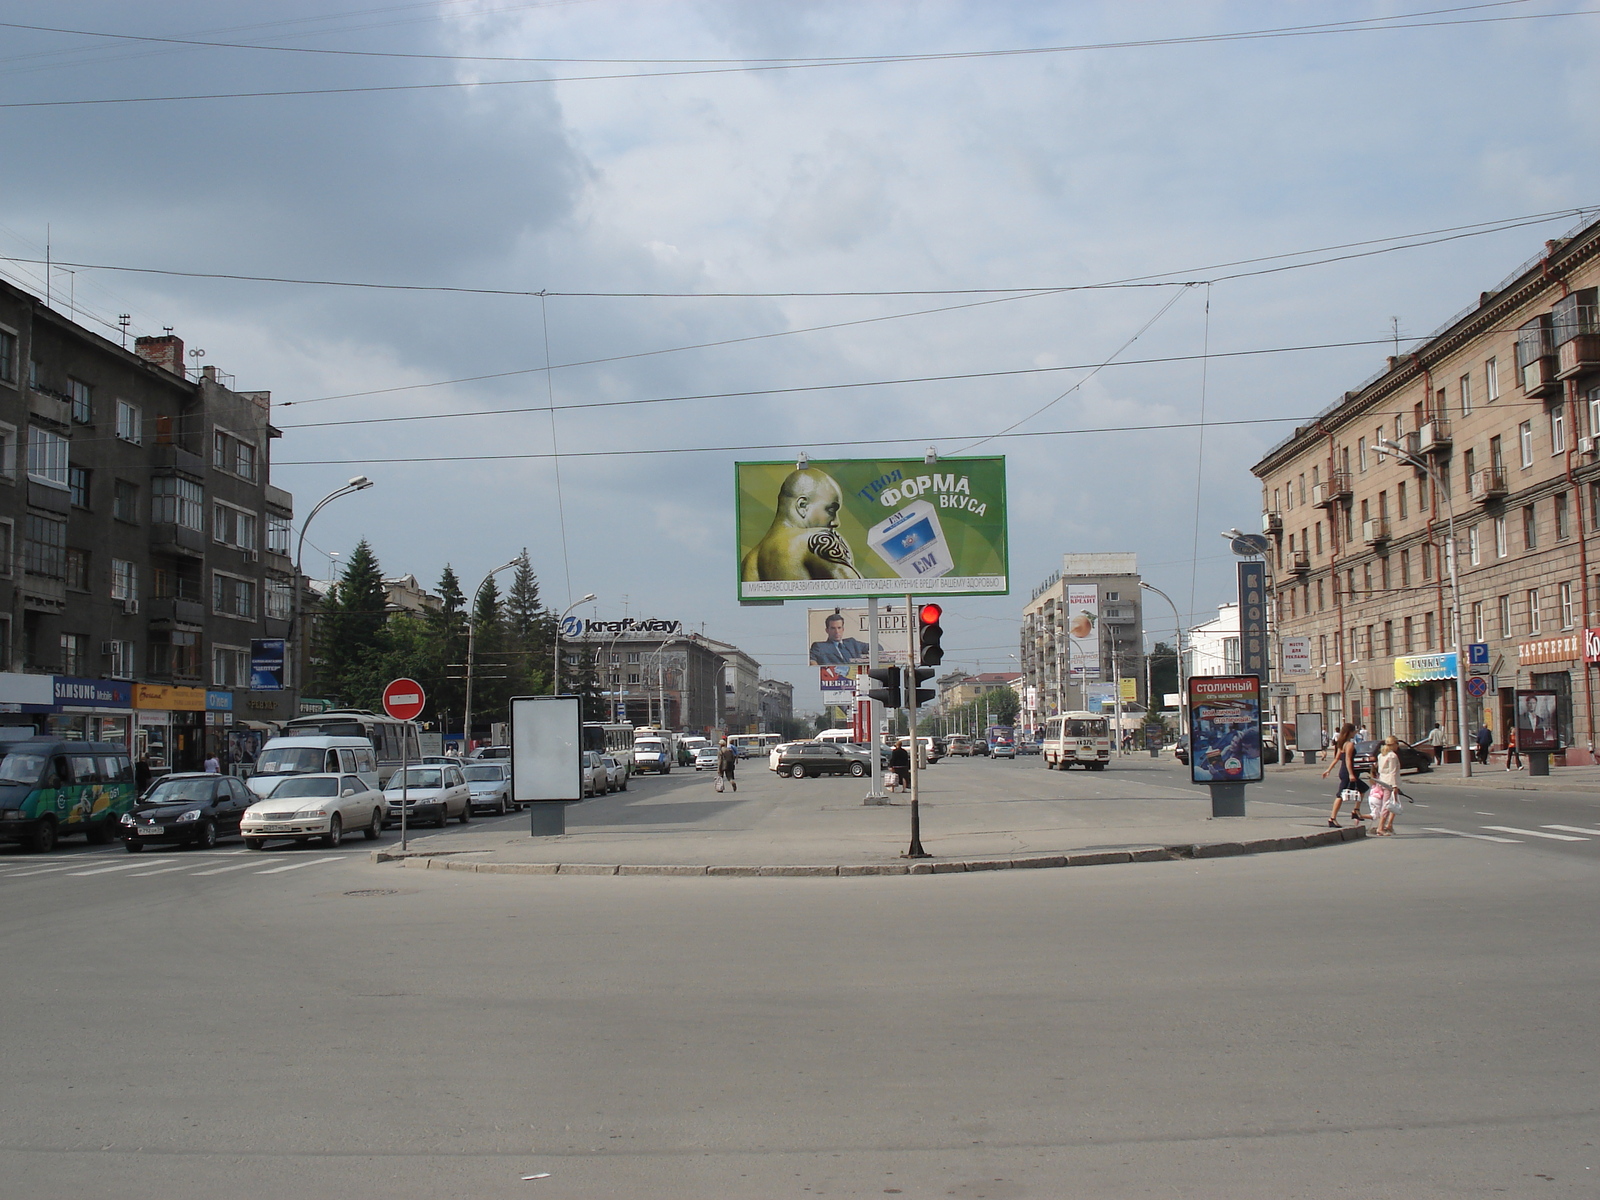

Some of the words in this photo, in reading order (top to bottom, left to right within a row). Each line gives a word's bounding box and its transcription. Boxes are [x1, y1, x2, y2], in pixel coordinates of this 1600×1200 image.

[857, 469, 903, 503] ТВОЯ
[880, 473, 970, 507] ФОРМА
[939, 494, 987, 517] ВКУСА
[748, 580, 820, 593] МИНЗДРАВСОЦРАЗВИТИЯ
[821, 580, 847, 591] РОССИИ
[895, 579, 919, 589] КУРЕНИЕ
[920, 578, 940, 589] ВРЕДИТ
[941, 578, 965, 588] ВАШЕМУ
[967, 577, 999, 588] ЗДОРОВЬЮ
[585, 618, 679, 633] kraftway
[1473, 646, 1485, 662] P
[1518, 635, 1578, 657] КАФЕТЕРИЙ
[55, 682, 95, 700] SAMSUNG
[1196, 681, 1253, 693] СТОЛИЧНЫЙ
